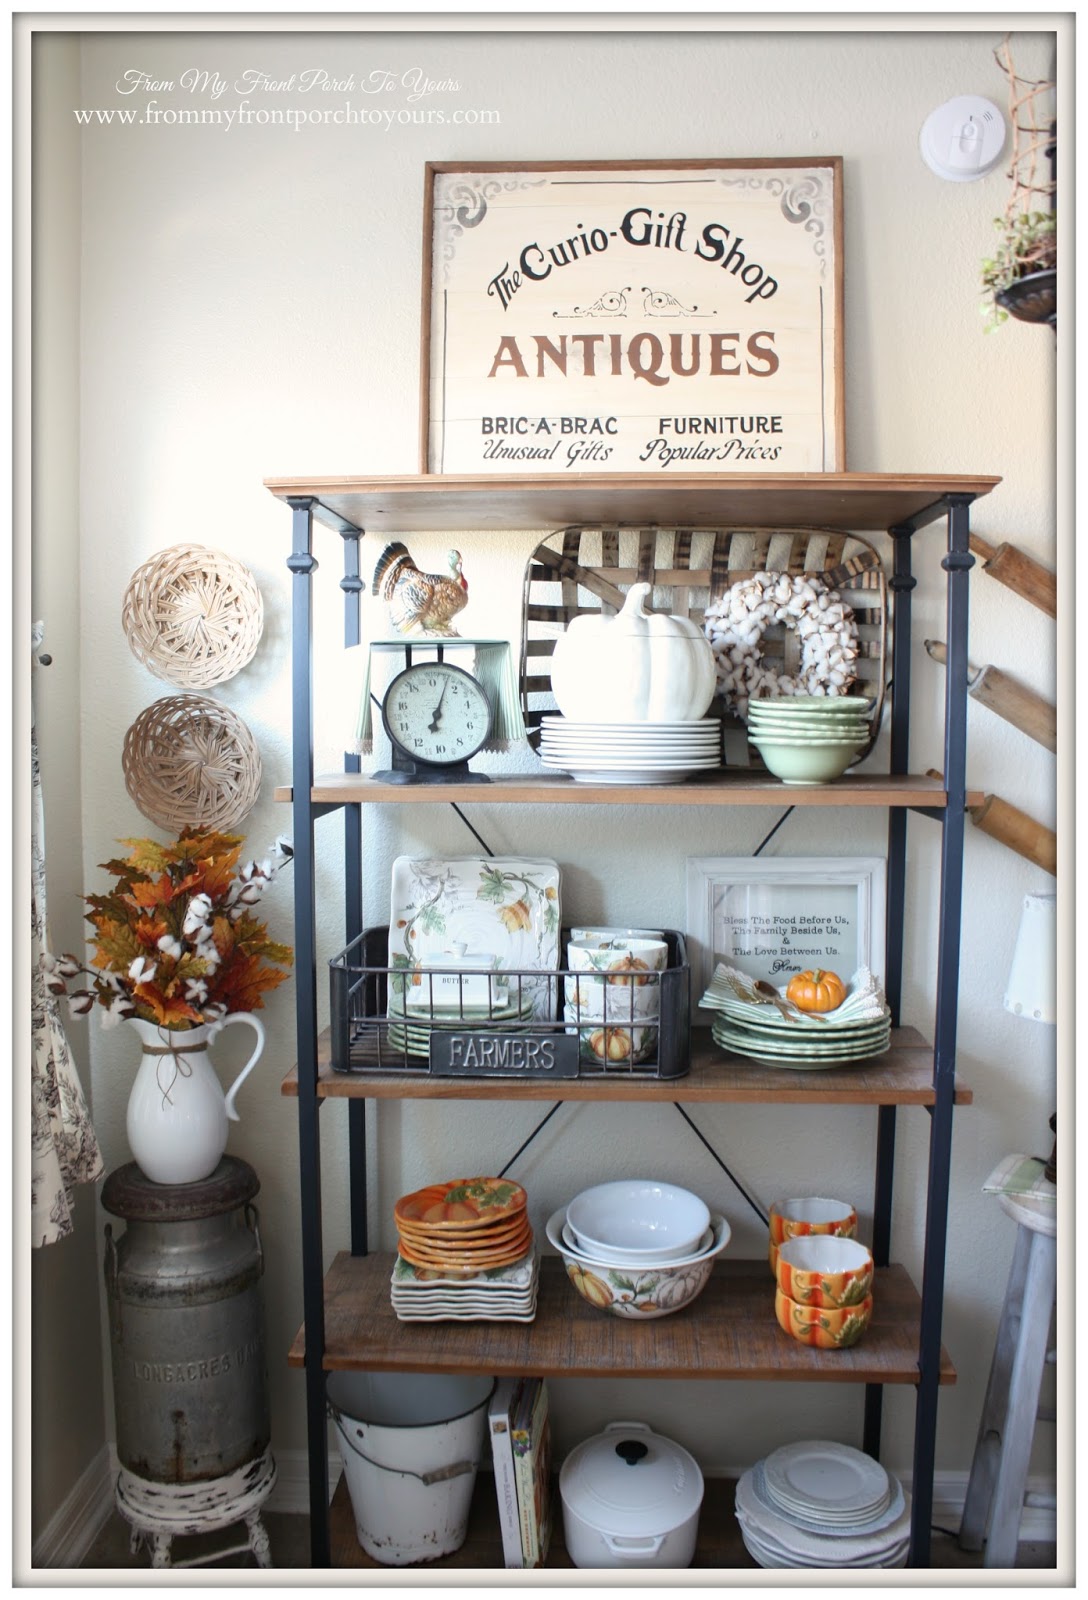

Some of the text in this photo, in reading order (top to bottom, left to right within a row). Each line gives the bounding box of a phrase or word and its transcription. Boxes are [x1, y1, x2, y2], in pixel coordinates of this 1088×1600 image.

[487, 207, 779, 312] The Curio-Gift Shop
[486, 331, 780, 387] ANTIQUES
[481, 416, 783, 436] BRIC-A-BRAC FURNITURE
[482, 437, 783, 468] Unusual Gifts Popular Prices
[428, 679, 437, 687] 0
[409, 684, 419, 693] 18
[451, 685, 458, 695] 2
[398, 700, 471, 711] 16 4
[466, 721, 474, 730] 6
[413, 737, 464, 747] 12 8
[435, 744, 446, 754] 10
[723, 915, 850, 925] Bless The Food Before Us,
[731, 926, 841, 936] The Family Beside Us,
[782, 937, 791, 945] &
[731, 947, 841, 956] The Love Between Us.
[449, 1037, 556, 1070] FARMERS
[133, 1353, 231, 1383] LONGACRES
